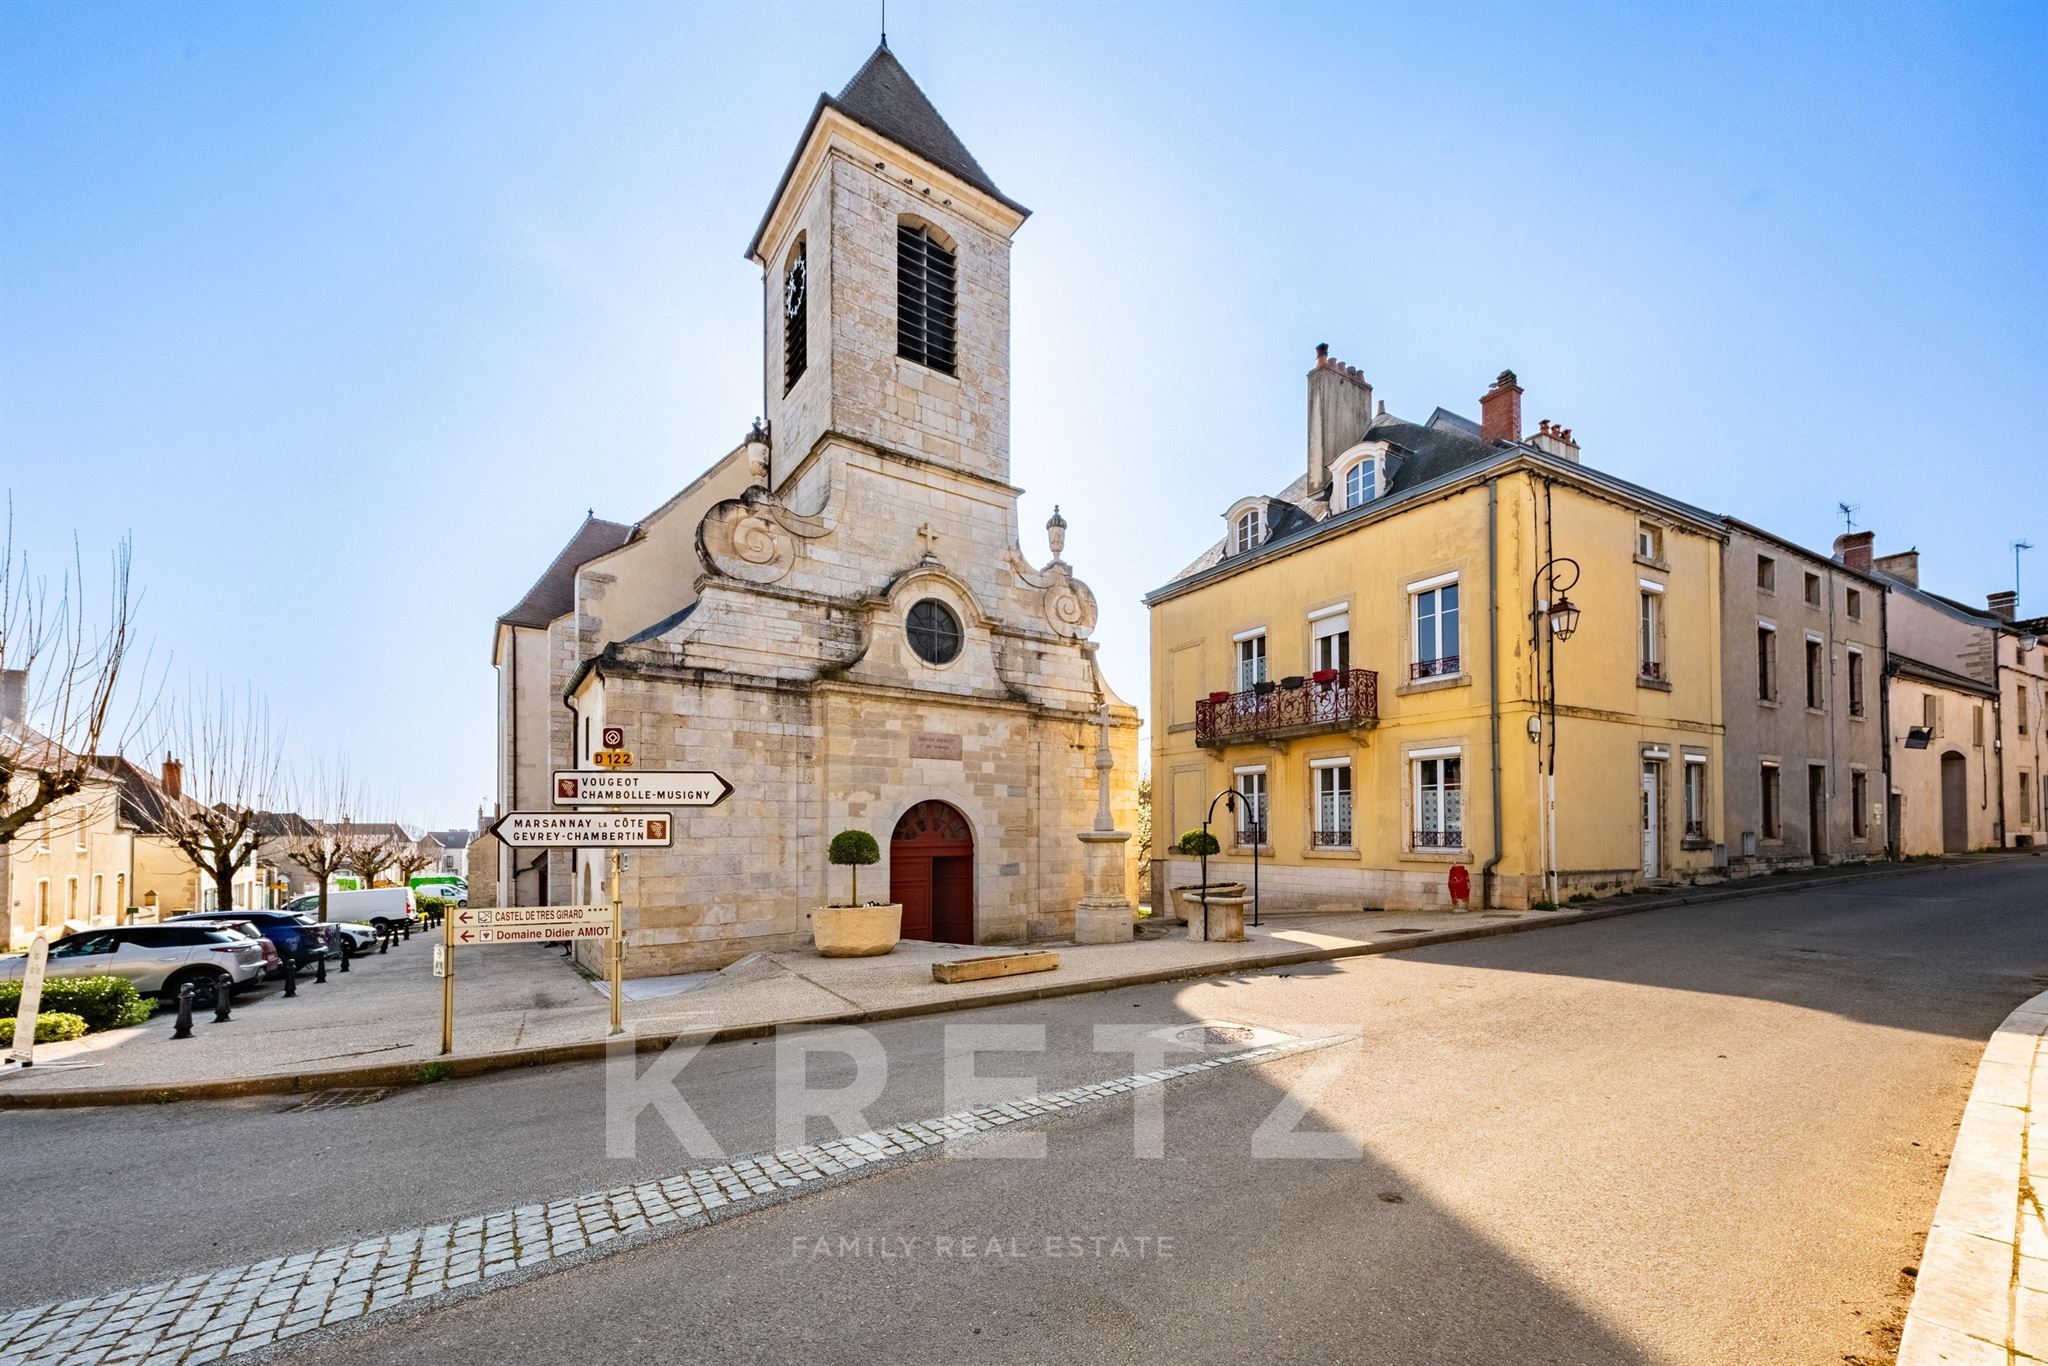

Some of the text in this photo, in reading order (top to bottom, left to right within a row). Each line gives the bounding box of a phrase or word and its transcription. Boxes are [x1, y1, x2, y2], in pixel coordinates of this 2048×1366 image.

[594, 752, 631, 765] D 122
[582, 777, 639, 787] VOUGEOT
[581, 790, 711, 800] CHAMBOLLE-MUSIGNY
[514, 819, 592, 828] MARSANNAY
[614, 817, 644, 828] CÔTE
[513, 831, 644, 841] GEVREY-CHAMBERTIN
[495, 909, 584, 922] CASTEL DE TRES GIRARD
[497, 926, 610, 940] Domaine Didier AMIOT
